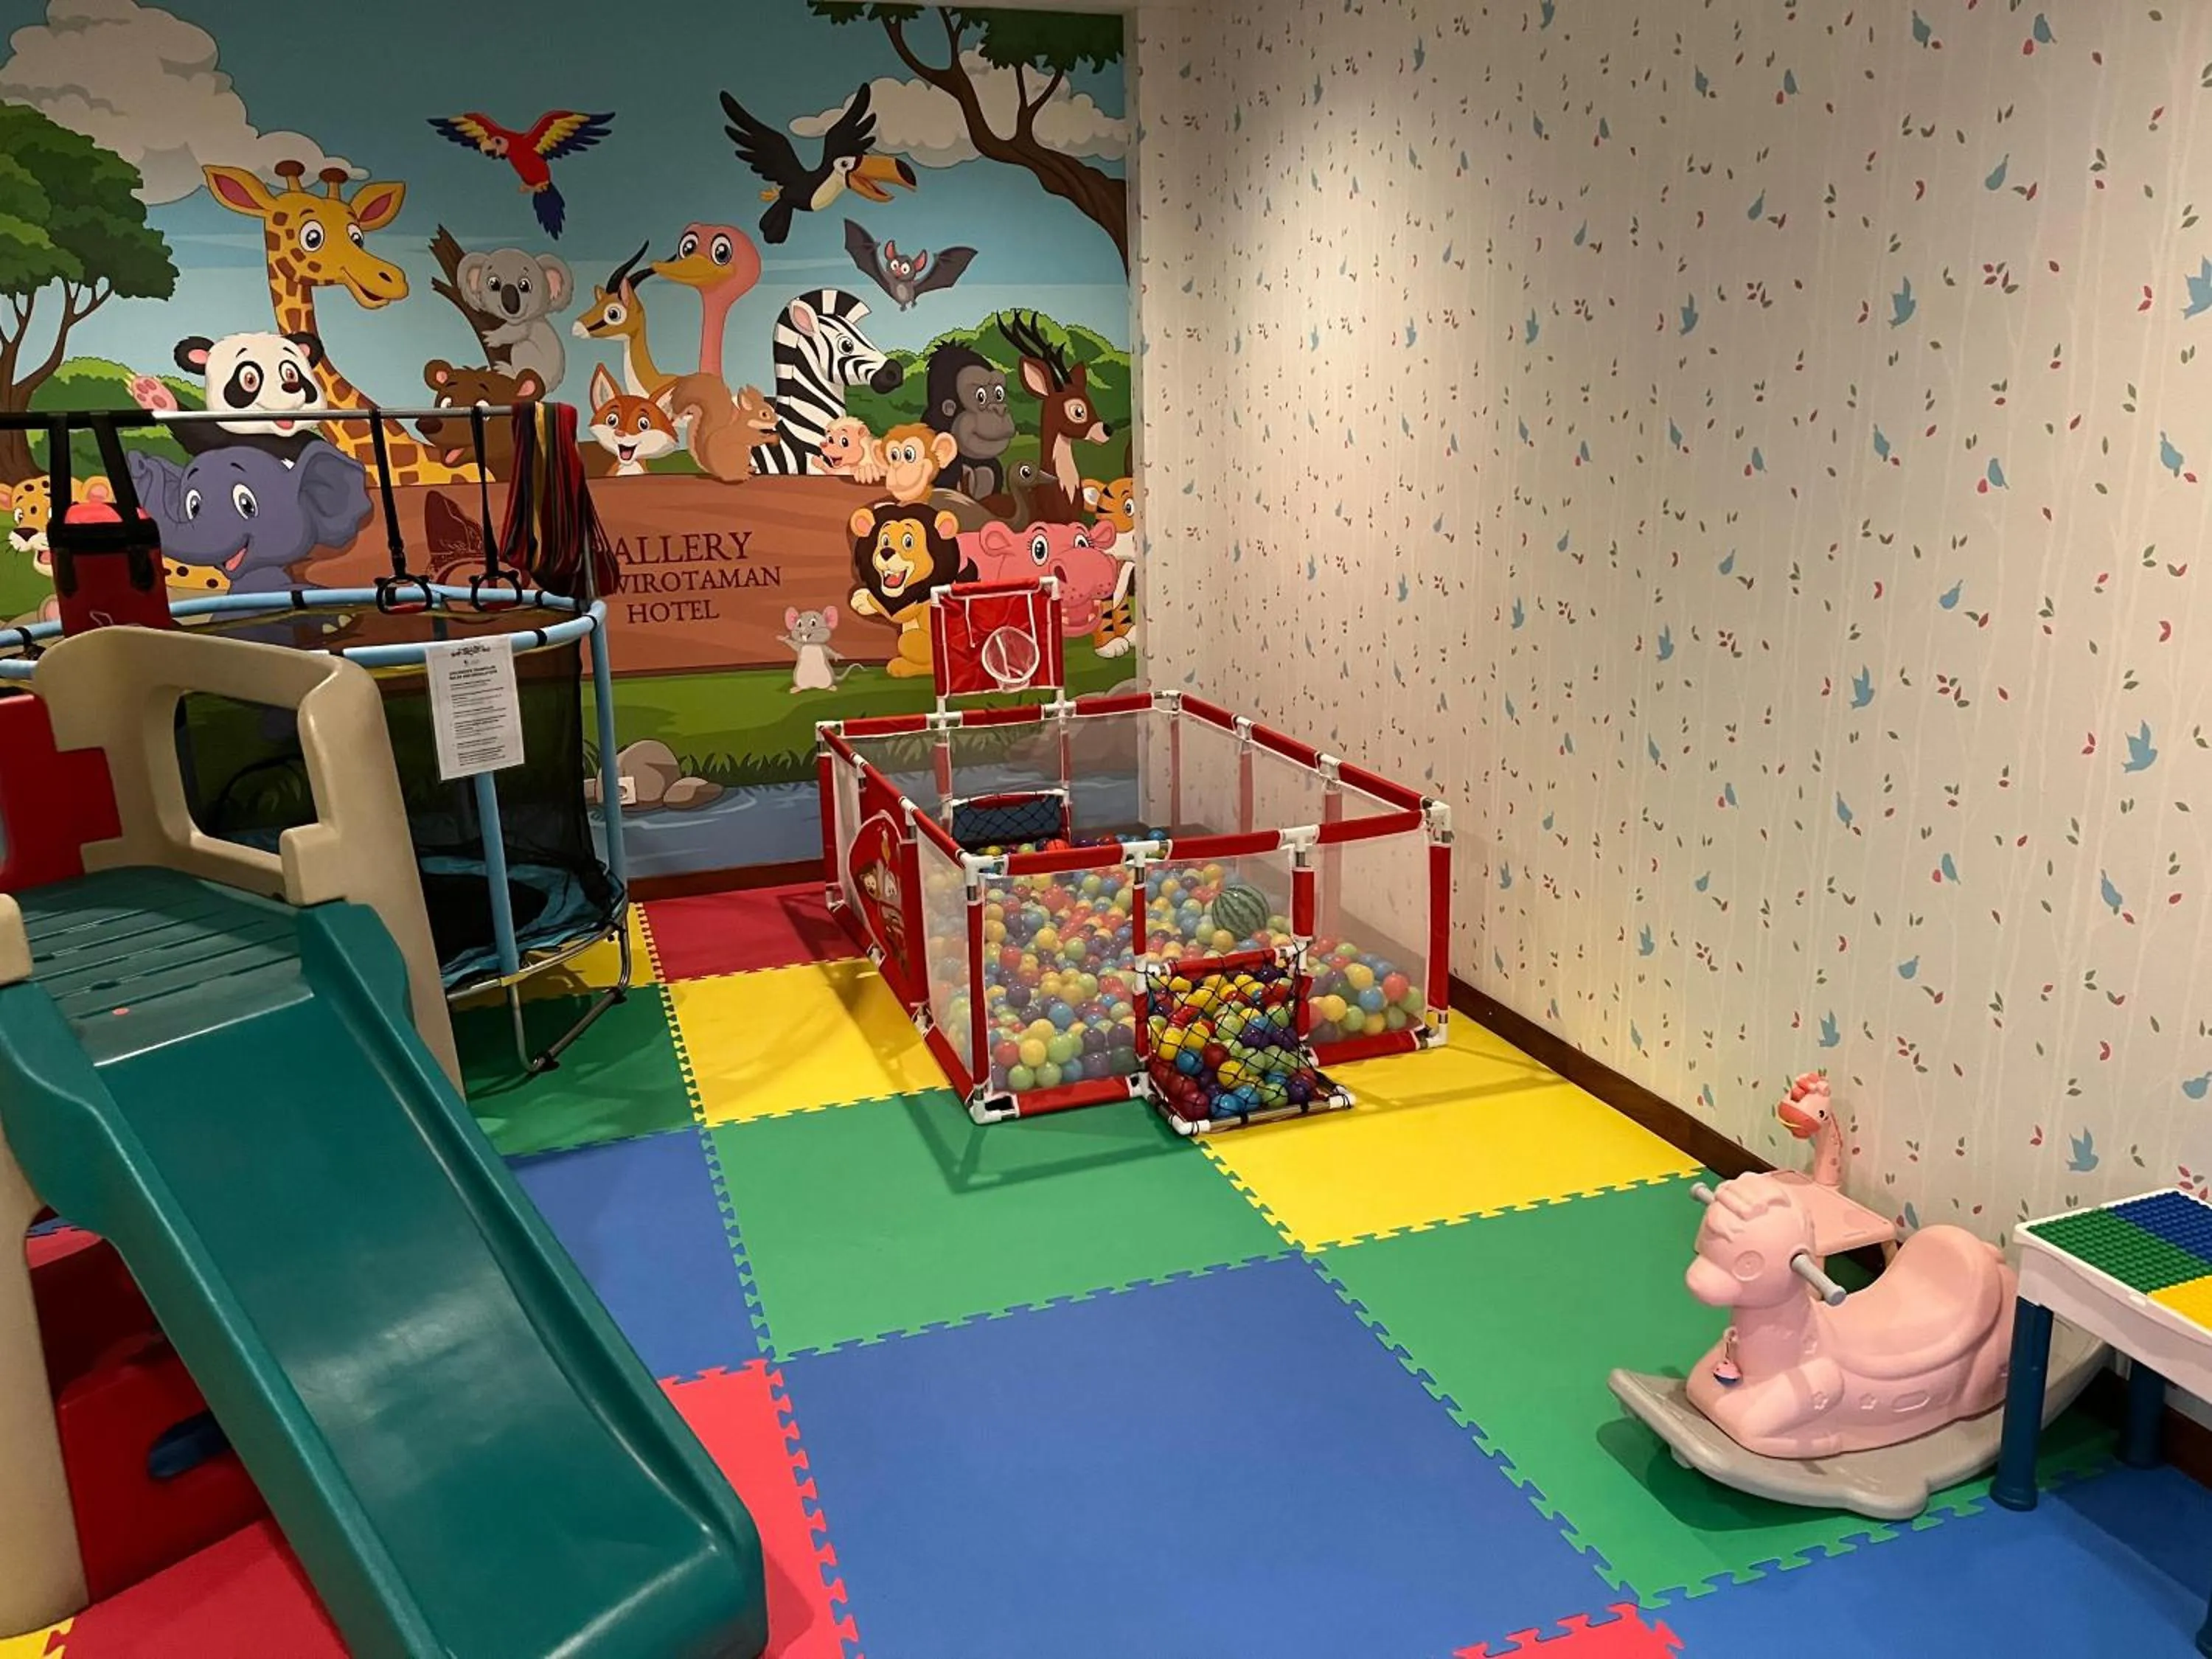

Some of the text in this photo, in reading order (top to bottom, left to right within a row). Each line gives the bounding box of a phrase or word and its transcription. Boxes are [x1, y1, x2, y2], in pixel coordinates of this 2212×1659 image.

[615, 531, 753, 566] ALLERY
[618, 566, 782, 596] WIROTAMAN
[627, 599, 720, 624] HOTEL
